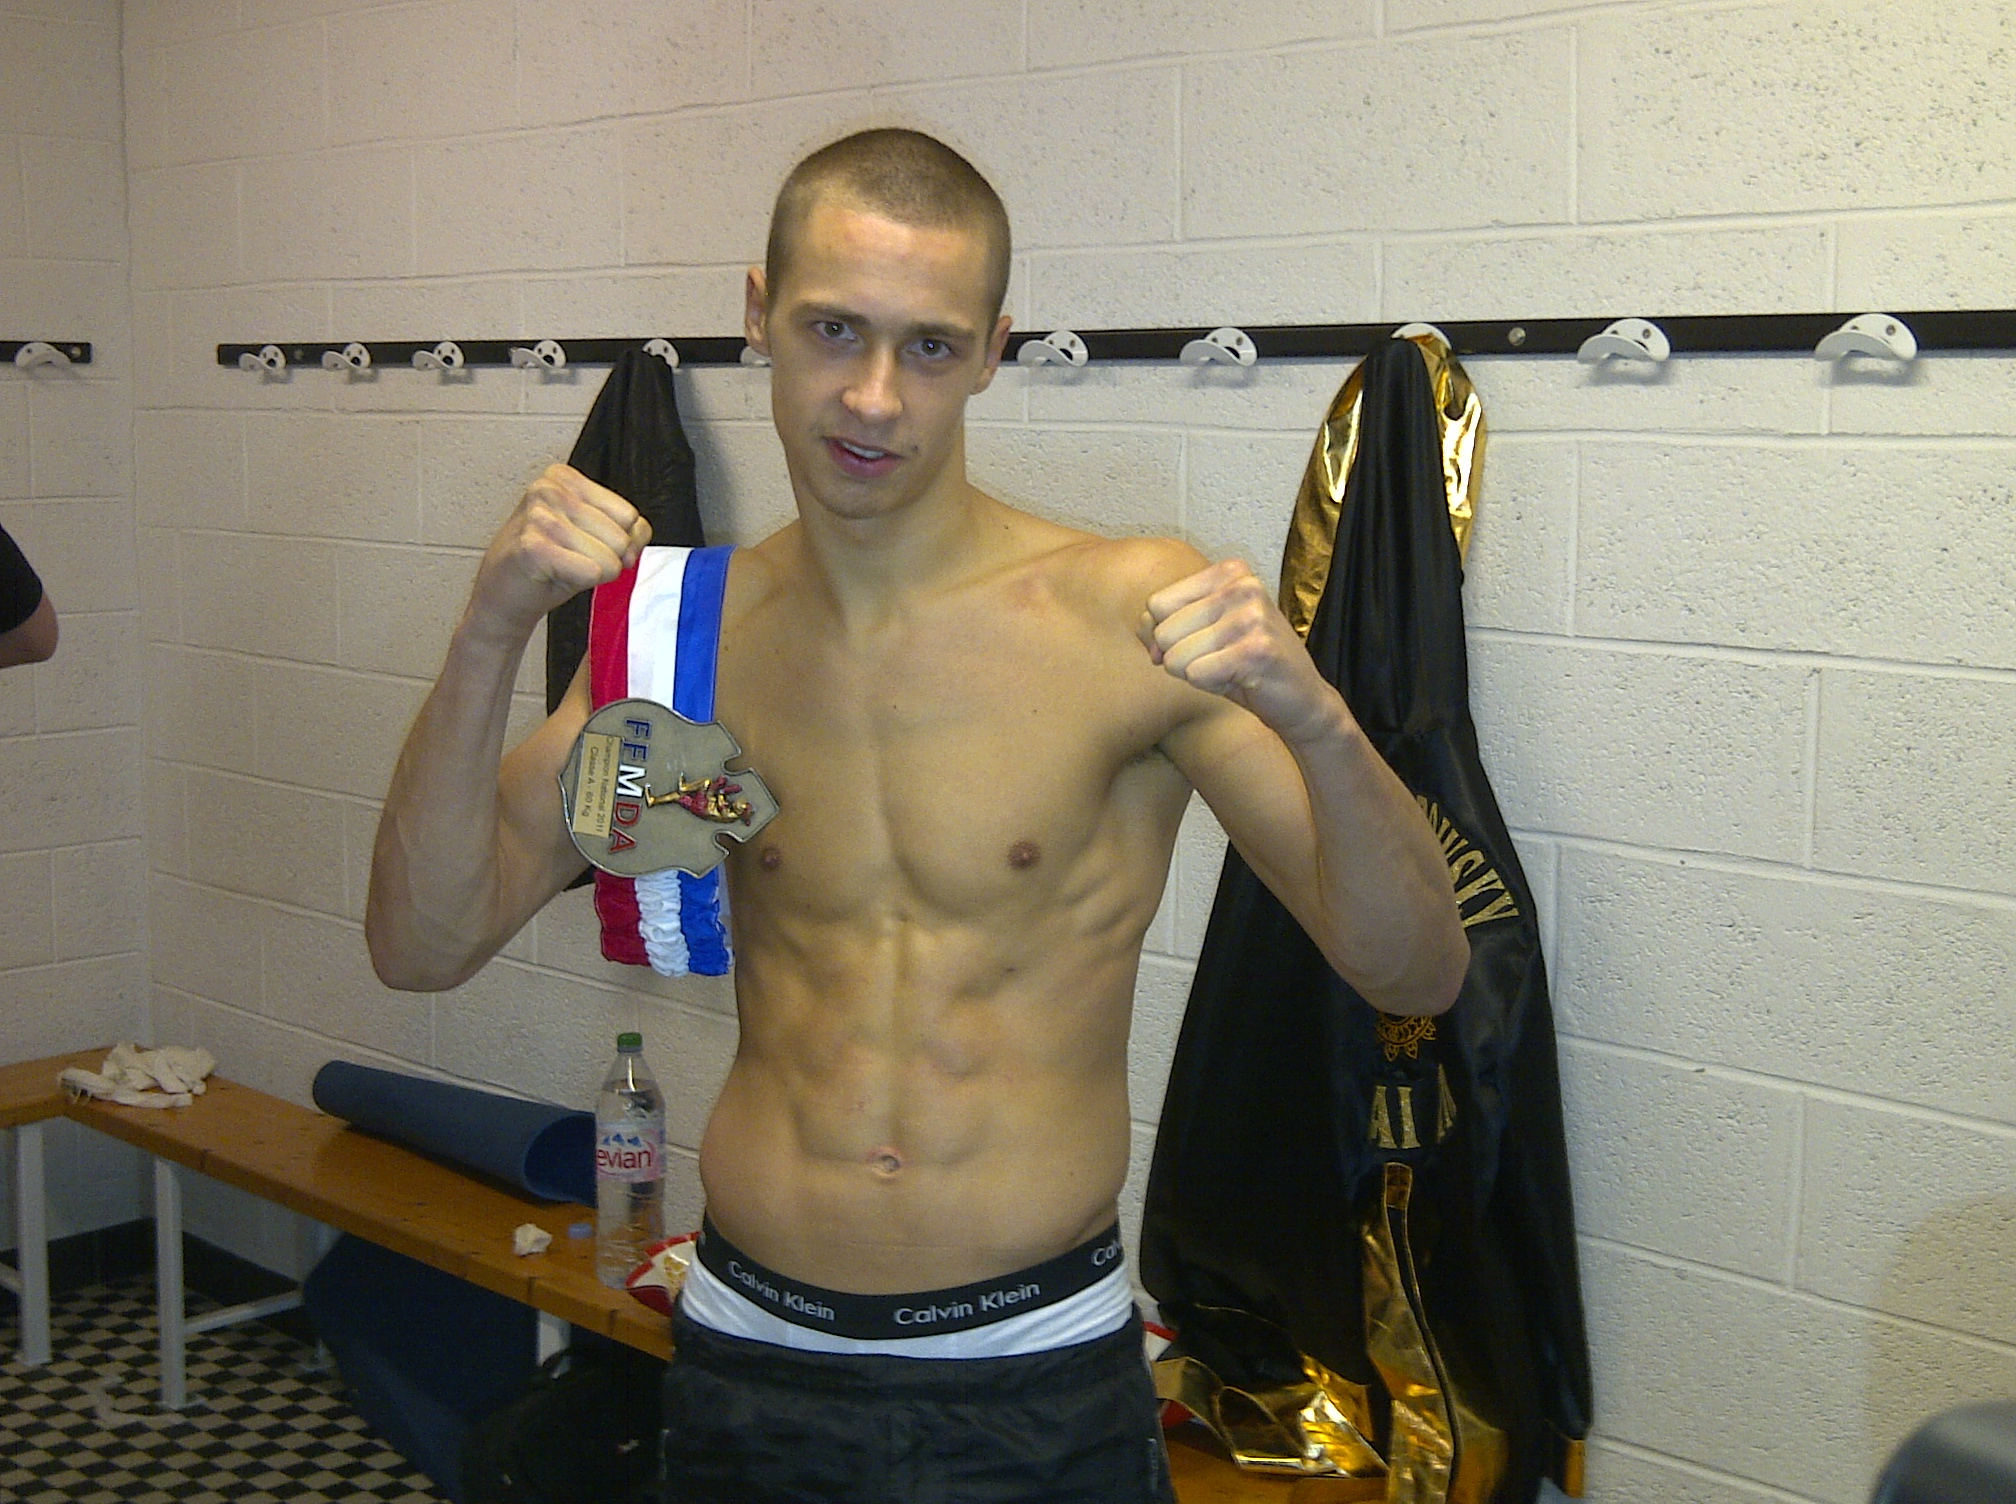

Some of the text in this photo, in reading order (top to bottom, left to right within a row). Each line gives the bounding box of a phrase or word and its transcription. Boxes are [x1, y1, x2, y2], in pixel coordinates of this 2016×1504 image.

[588, 746, 599, 776] Classe
[596, 736, 615, 832] Champion National 2011
[609, 719, 653, 854] FFMDA
[595, 1148, 652, 1169] evian
[728, 1260, 835, 1321] Calvin Klein
[894, 1282, 1042, 1325] Calvin Klein
